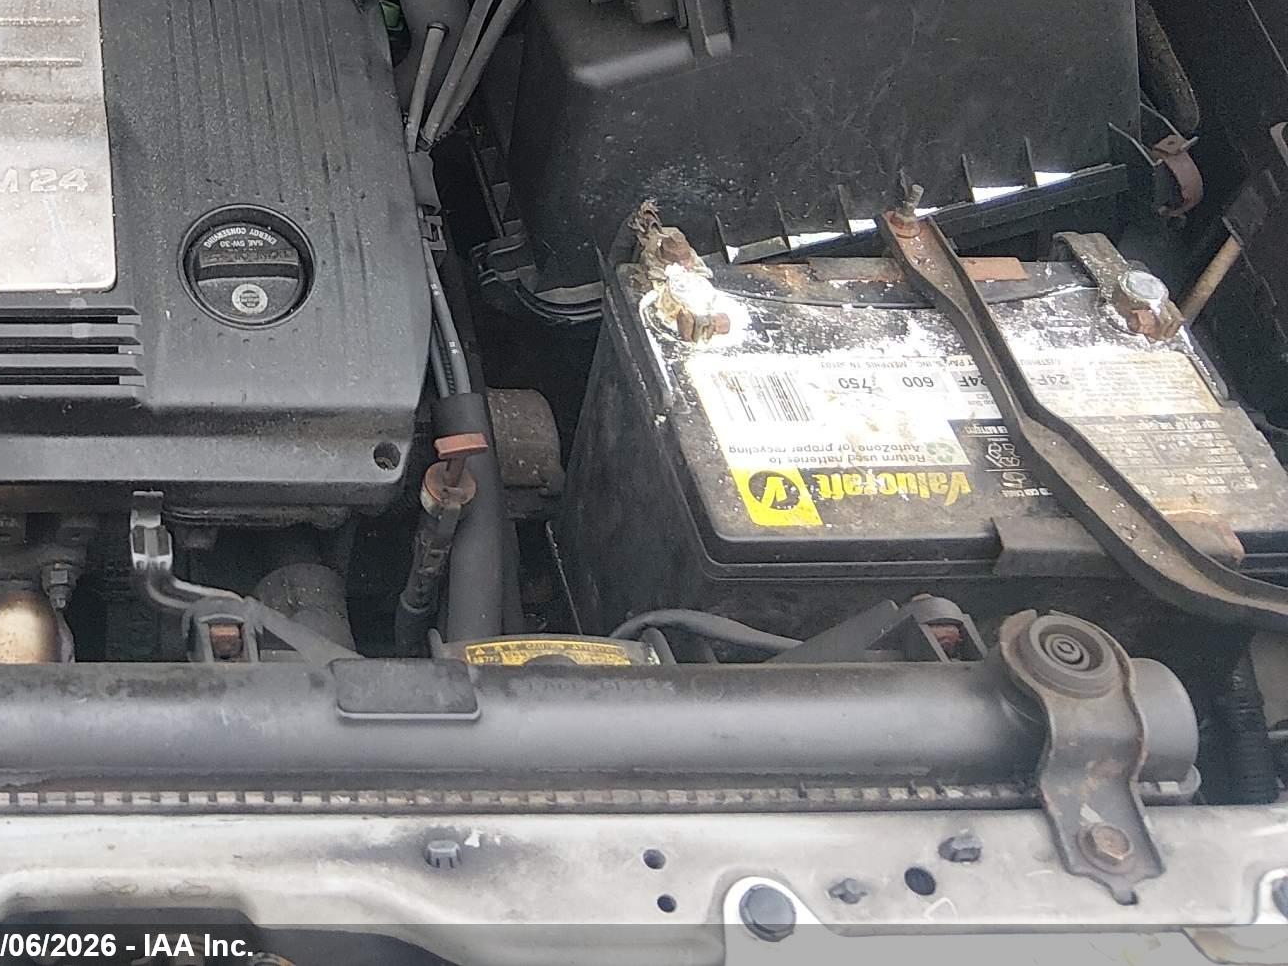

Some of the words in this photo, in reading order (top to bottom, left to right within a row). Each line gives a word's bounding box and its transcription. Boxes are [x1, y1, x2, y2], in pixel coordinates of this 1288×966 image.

[28, 167, 90, 194] 24
[203, 227, 247, 249] CONSERVING
[248, 228, 278, 246] ENERGY
[248, 239, 264, 247] SAE
[838, 376, 872, 390] 750
[901, 376, 935, 388] 600
[792, 443, 833, 453] proper
[859, 443, 920, 453] AutoZone
[848, 453, 878, 464] used
[881, 453, 926, 464] Return
